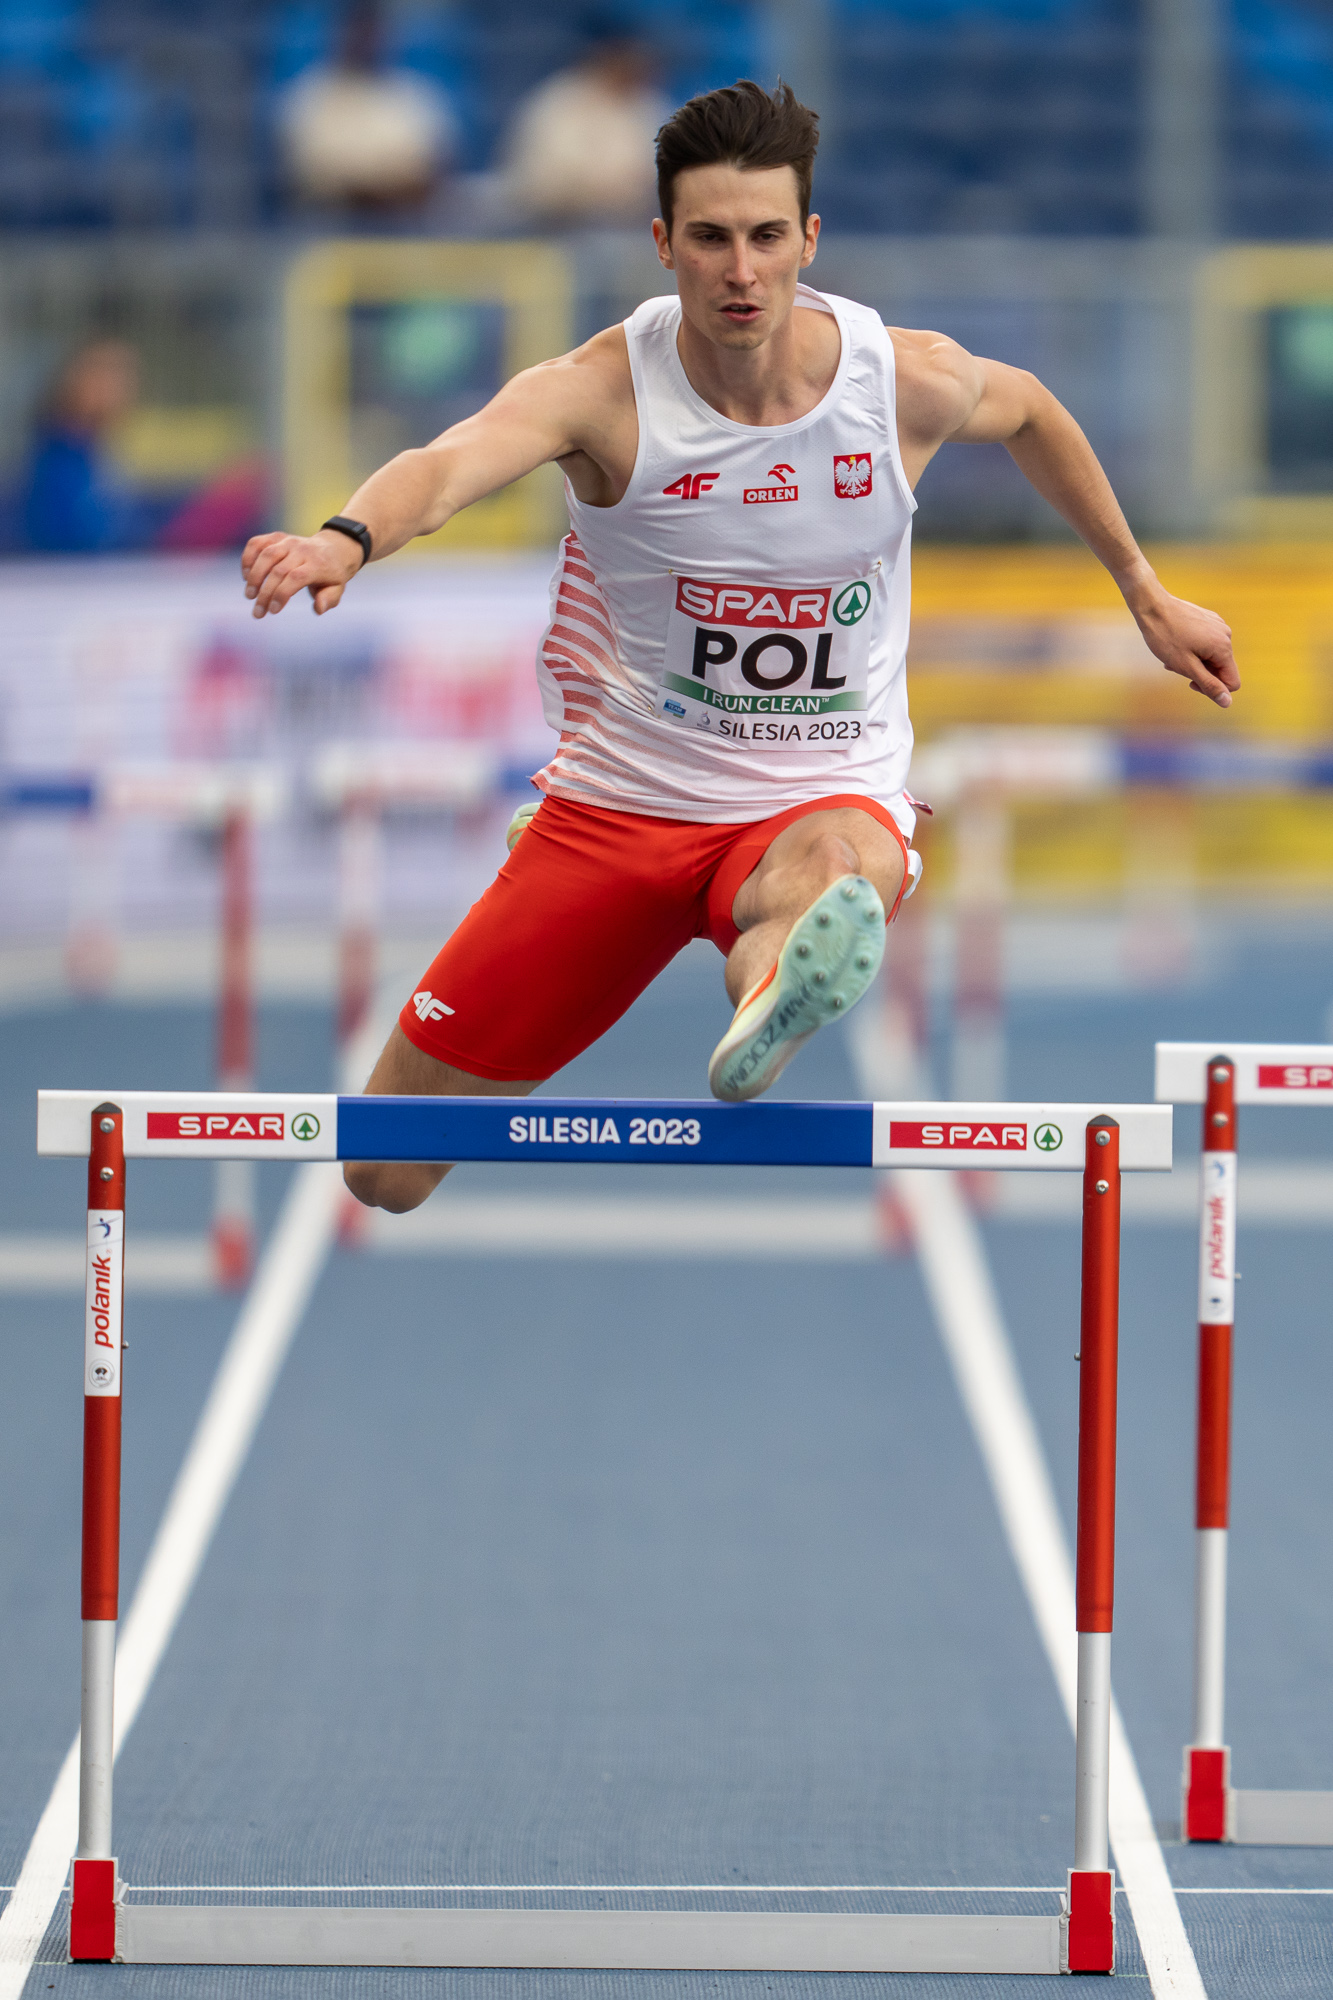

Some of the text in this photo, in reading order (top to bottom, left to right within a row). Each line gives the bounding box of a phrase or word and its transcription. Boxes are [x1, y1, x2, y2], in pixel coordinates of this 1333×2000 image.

[745, 487, 796, 502] ORLEN
[680, 582, 826, 624] SPAR
[691, 626, 847, 691] POL
[703, 688, 709, 701] I
[711, 691, 752, 712] RUN
[718, 719, 862, 742] SILESIA 2023
[1283, 1066, 1333, 1087] SP
[178, 1115, 283, 1137] SPAR
[509, 1115, 702, 1146] SILESIA 2023
[921, 1125, 1025, 1147] SPAR
[1207, 1195, 1229, 1280] polanik
[91, 1253, 115, 1349] polanik
